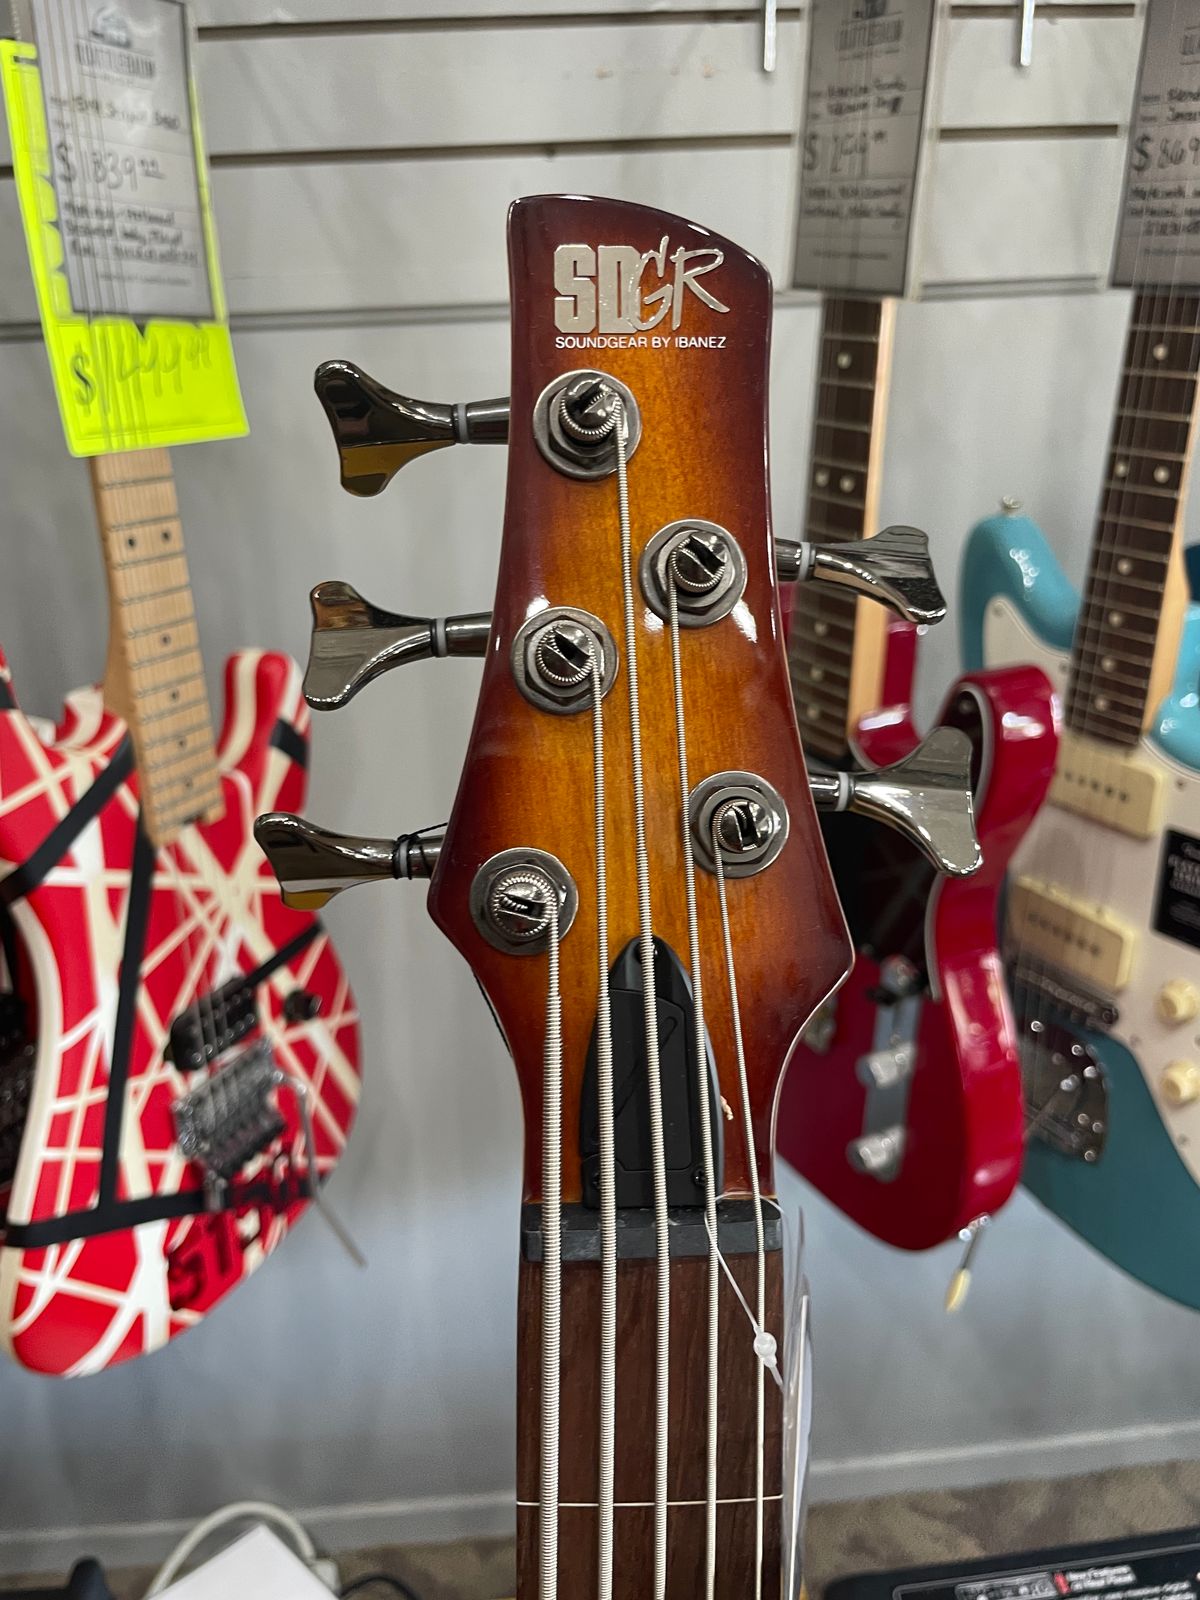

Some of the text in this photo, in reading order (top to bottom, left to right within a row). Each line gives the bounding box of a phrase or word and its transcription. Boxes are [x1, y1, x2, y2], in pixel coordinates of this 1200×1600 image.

[555, 336, 727, 349] SOUNDGEAR BY IBANEZ
